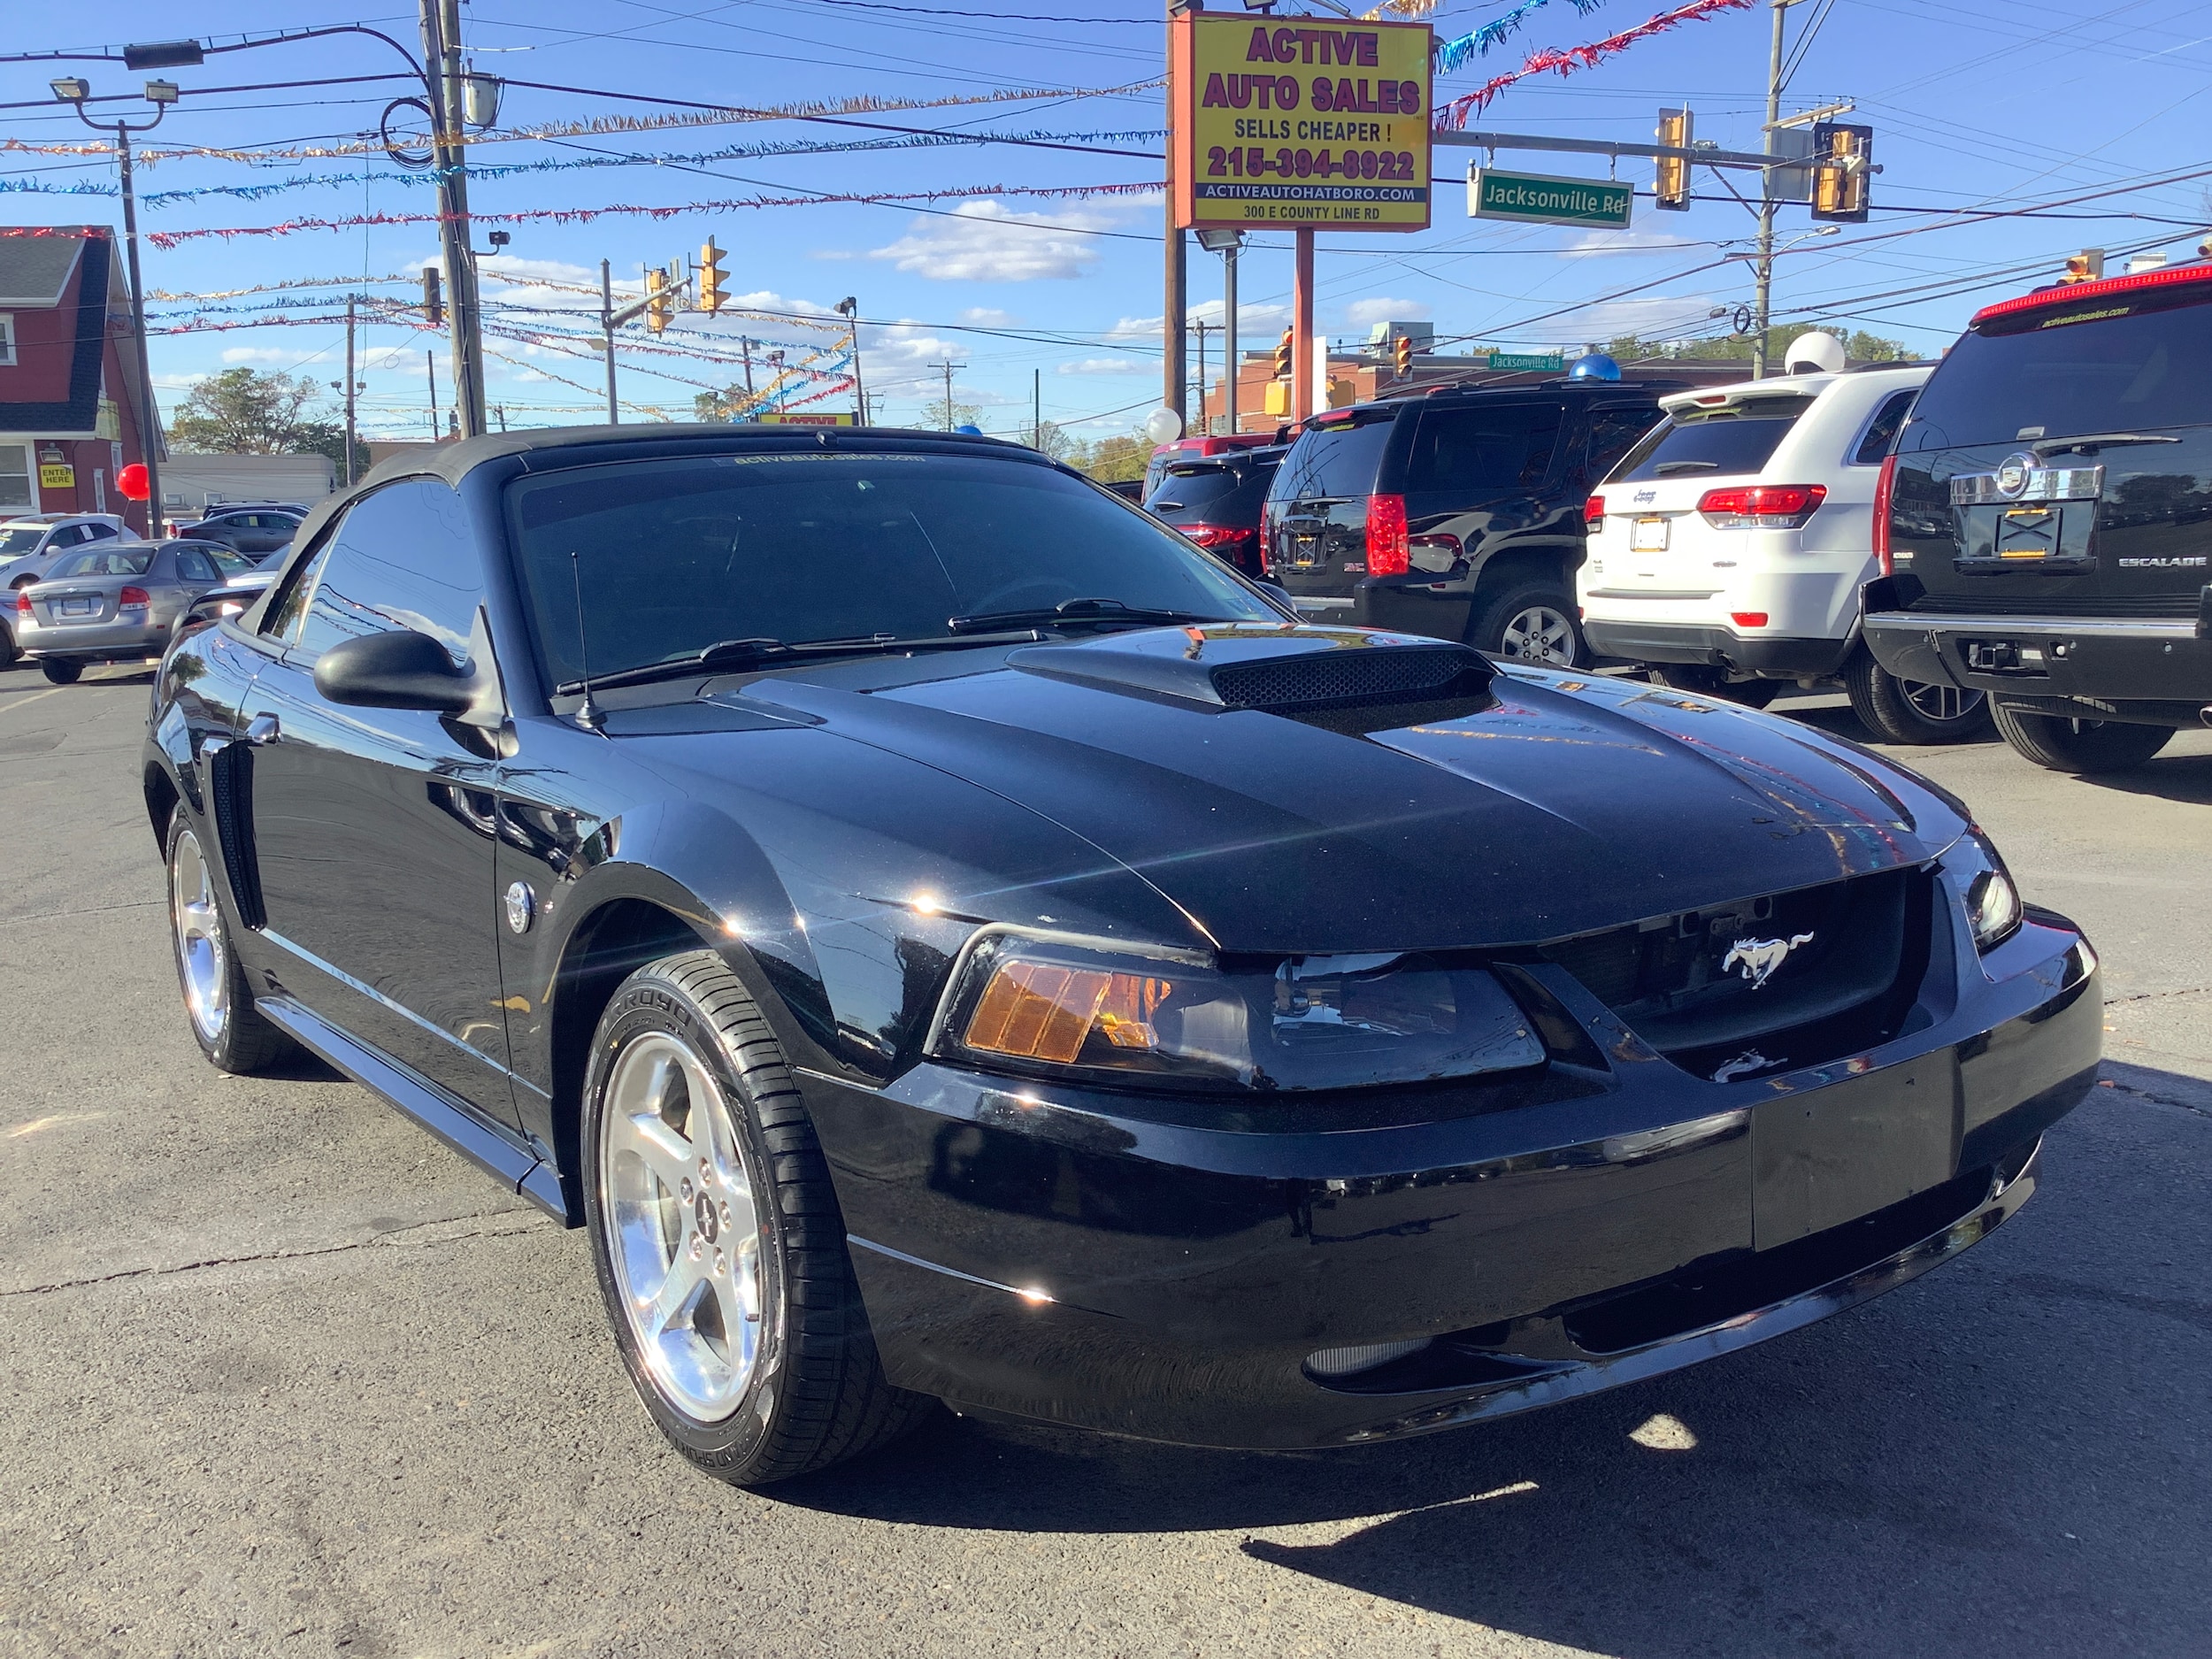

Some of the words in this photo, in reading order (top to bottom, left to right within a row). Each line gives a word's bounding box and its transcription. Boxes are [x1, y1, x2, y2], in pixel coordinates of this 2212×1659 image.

[1246, 27, 1379, 66] ACTIVE
[1202, 73, 1300, 111] AUTO
[1310, 76, 1420, 115] SALES
[1234, 119, 1290, 139] SELLS
[1297, 120, 1380, 142] CHEAPER
[1207, 146, 1414, 180] 215-394-8922
[1205, 184, 1415, 201] ACTIVEAUTOHATBORO.COM
[1486, 184, 1597, 211] Jacksonville
[1602, 195, 1624, 214] Rd
[1244, 205, 1264, 218] 300
[1269, 206, 1276, 218] E
[1279, 206, 1330, 219] COUNTY
[1333, 207, 1360, 219] LINE
[1364, 207, 1379, 219] RD
[2042, 307, 2130, 328] activeautosales.com
[1493, 356, 1546, 369] Jacksonville
[1548, 357, 1559, 369] Rd
[734, 454, 926, 465] activeautosales.com
[2118, 557, 2207, 567] ESCALADE
